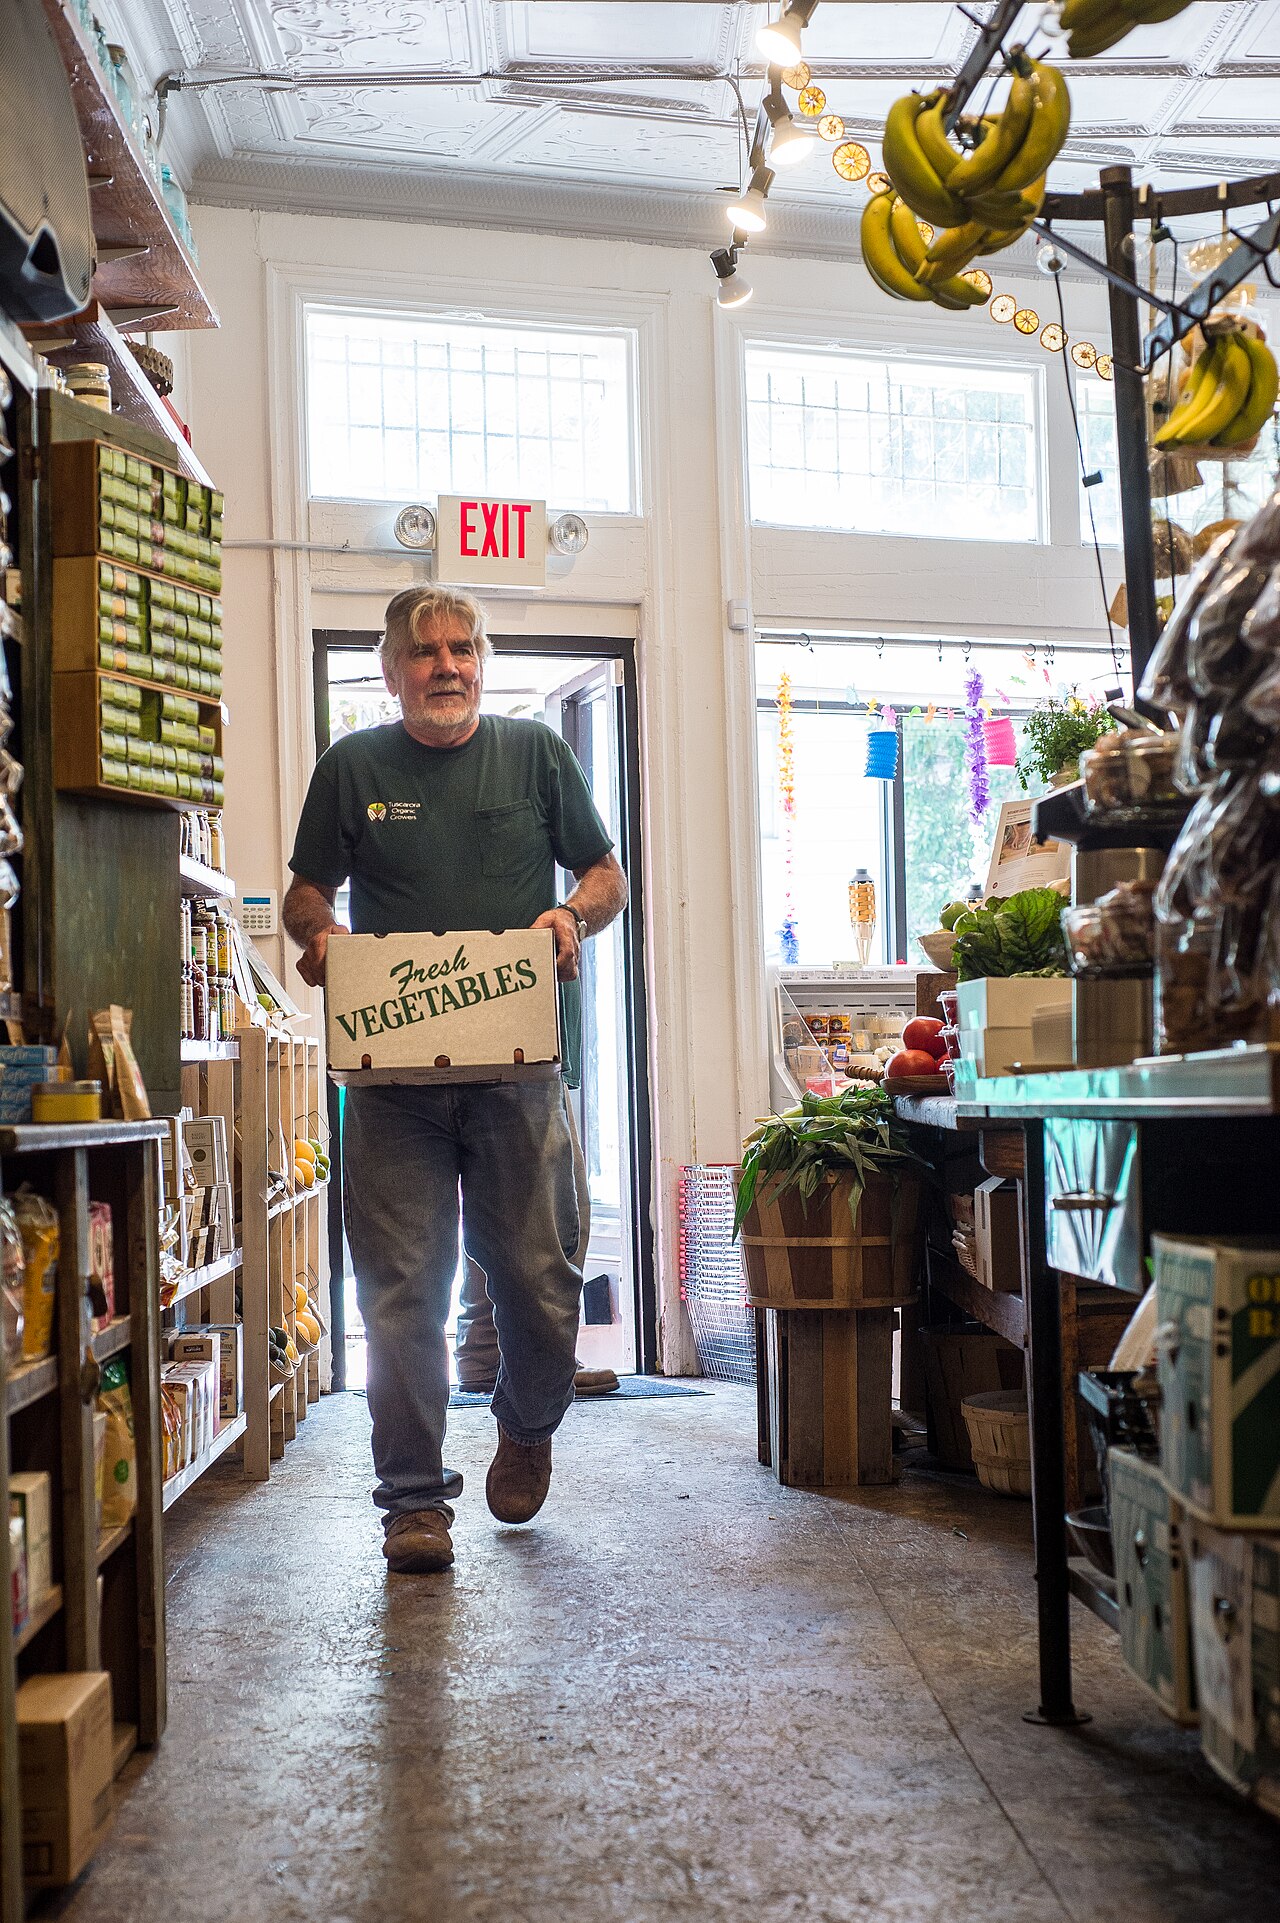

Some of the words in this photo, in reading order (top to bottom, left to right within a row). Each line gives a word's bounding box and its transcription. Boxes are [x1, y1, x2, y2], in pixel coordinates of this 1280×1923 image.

[460, 502, 531, 559] EXIT
[390, 944, 470, 995] Fresh
[335, 958, 538, 1042] VEGETABLES
